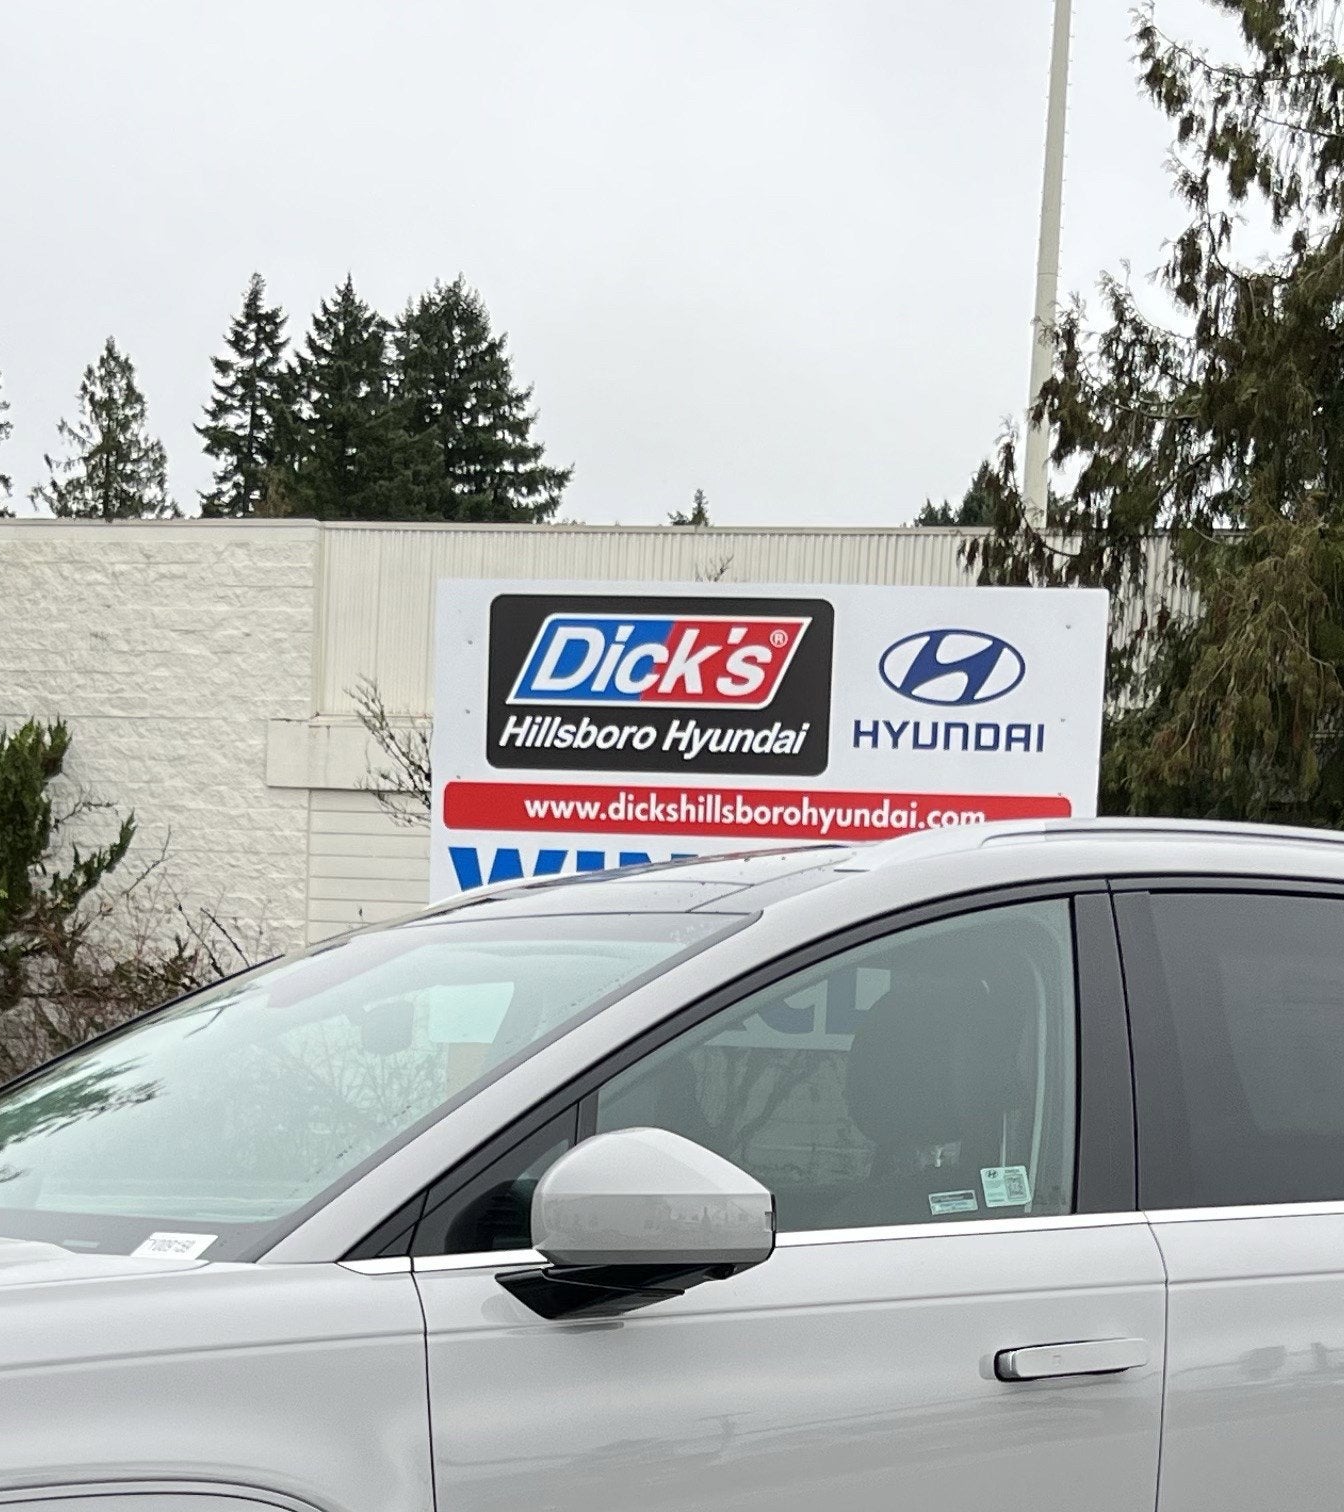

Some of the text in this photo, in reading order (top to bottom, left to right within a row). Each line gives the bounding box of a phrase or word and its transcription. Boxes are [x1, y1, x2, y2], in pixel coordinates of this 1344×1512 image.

[498, 714, 811, 760] Hillsboro Hyundai
[852, 719, 1044, 753] HYUNDAI
[524, 791, 986, 836] www.dickshillsborohyundai.com
